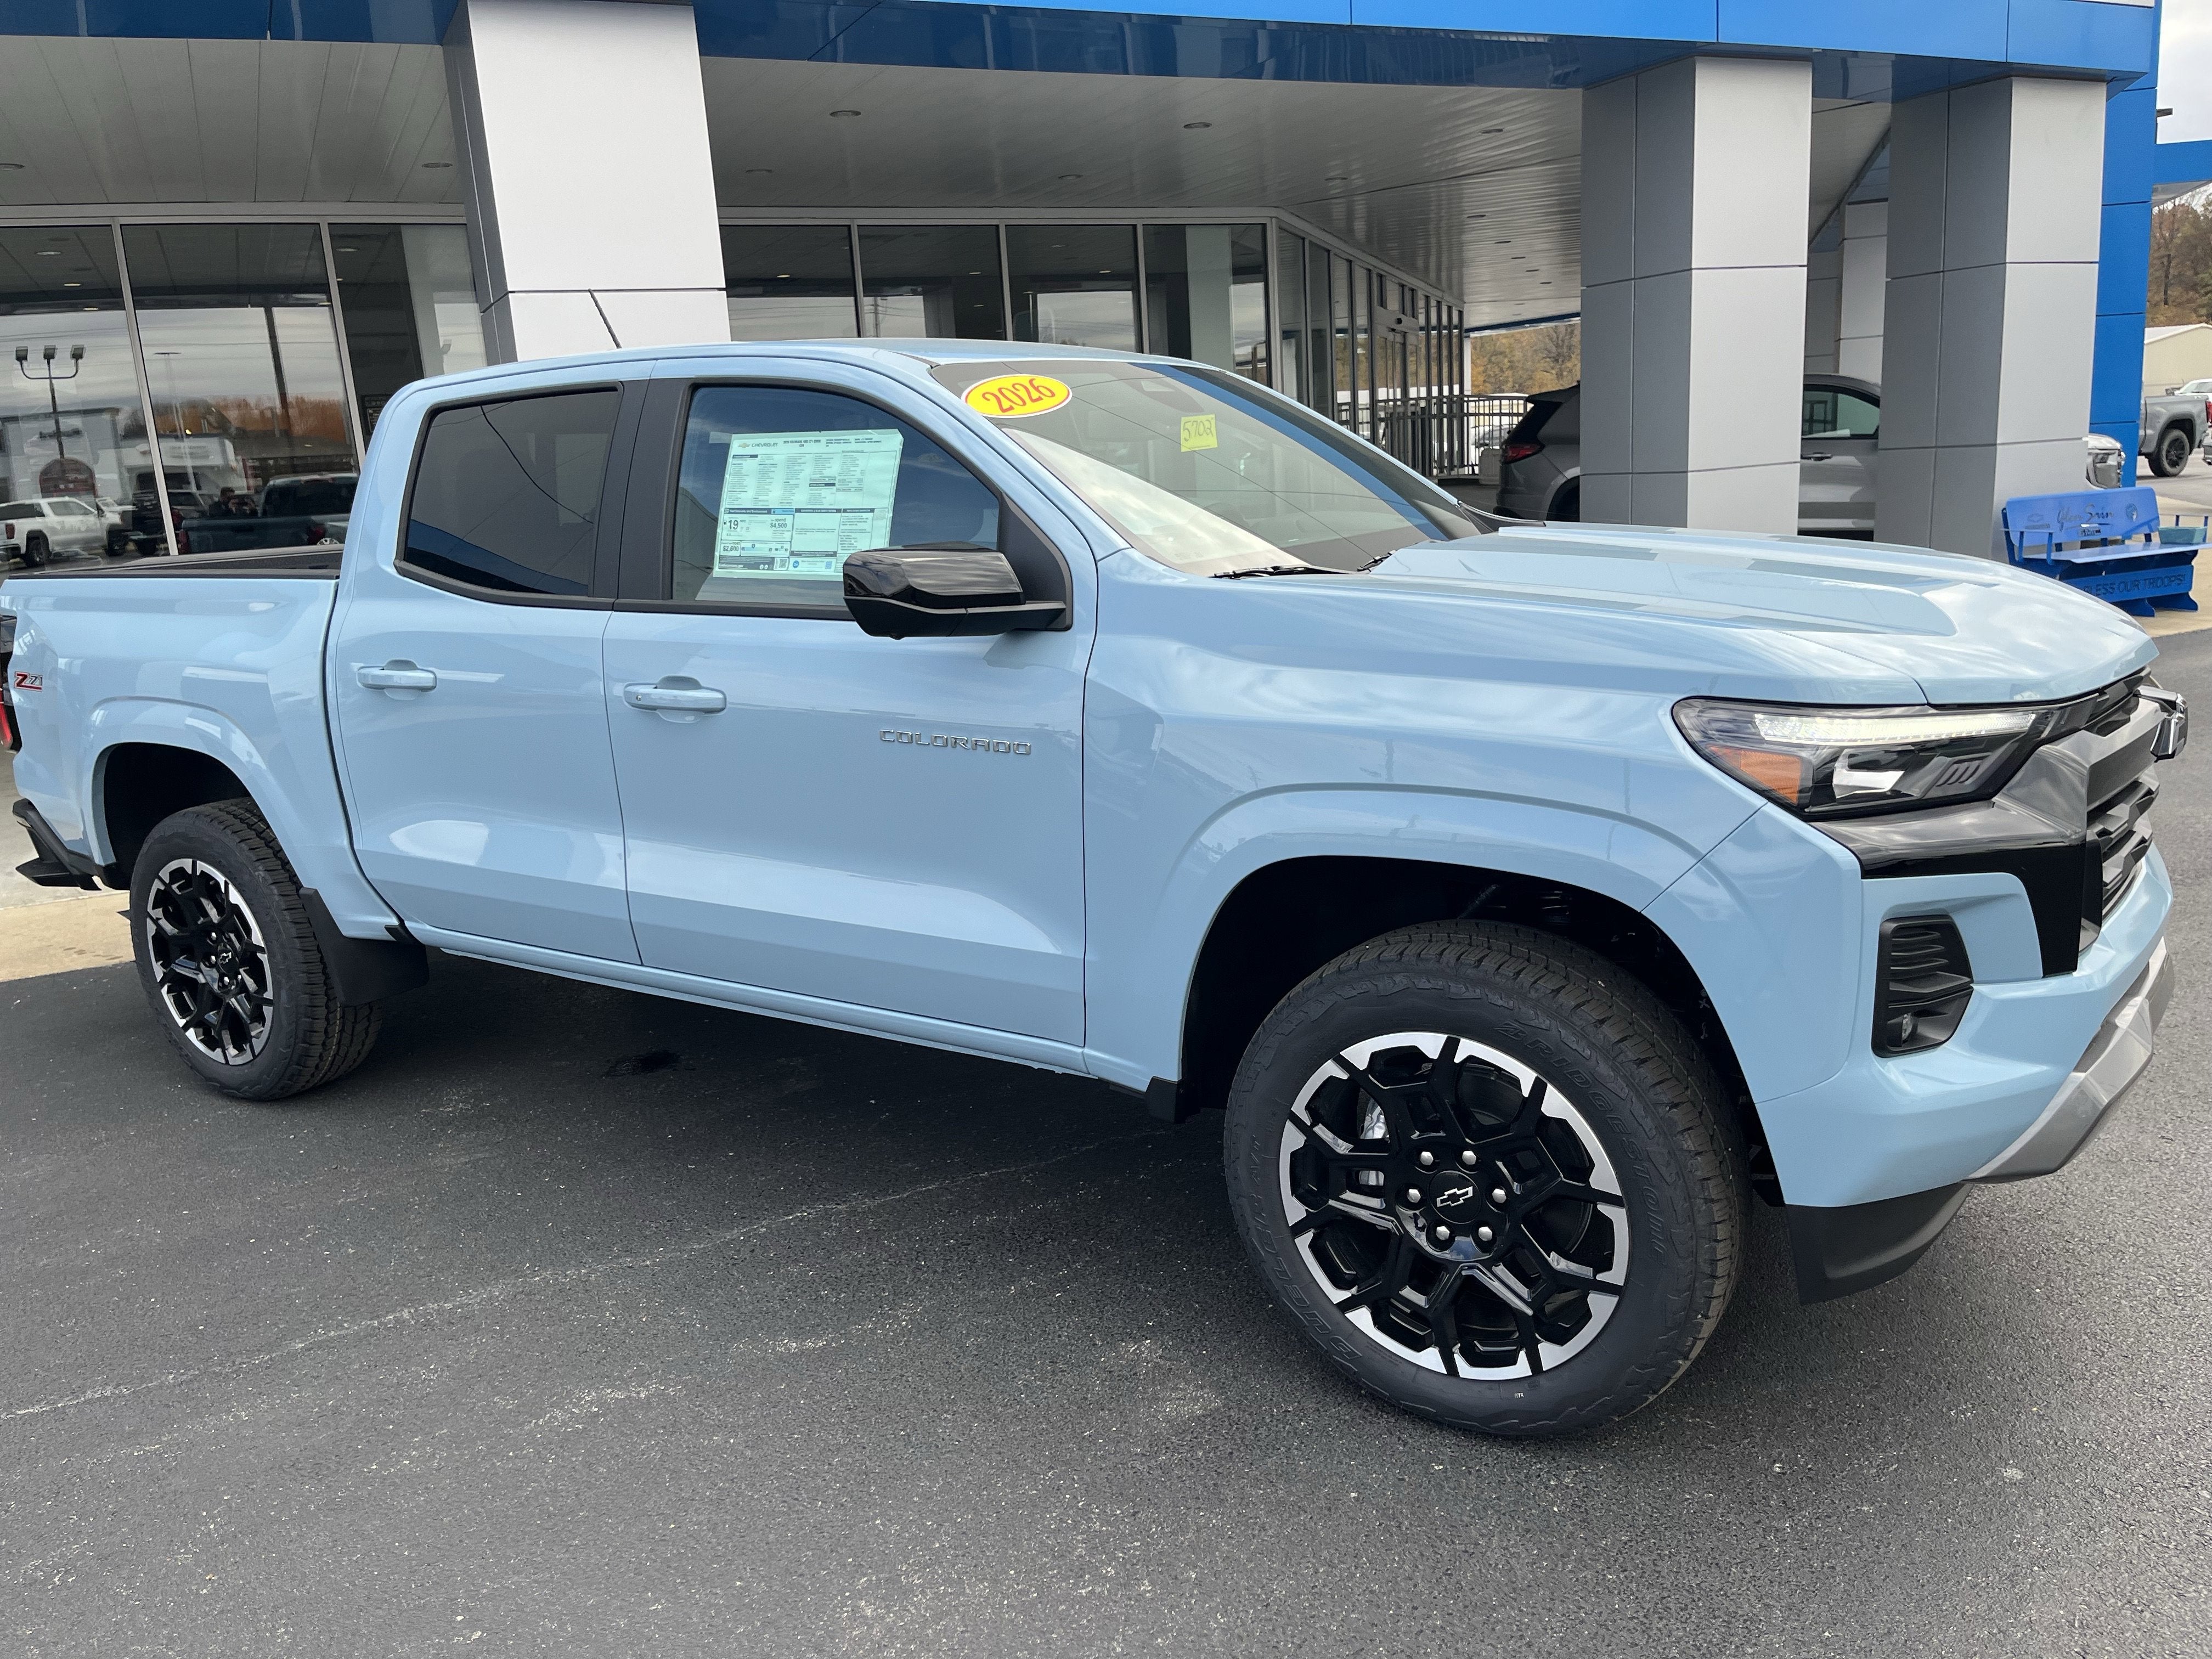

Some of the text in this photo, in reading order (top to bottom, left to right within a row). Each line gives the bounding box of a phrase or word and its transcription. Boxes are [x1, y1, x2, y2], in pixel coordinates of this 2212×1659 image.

[982, 378, 1056, 413] 2026
[1183, 419, 1214, 442] 5702
[728, 520, 739, 530] 19
[2119, 579, 2140, 593] OUR
[14, 671, 43, 692] Z71
[879, 729, 1031, 755] COLORADO
